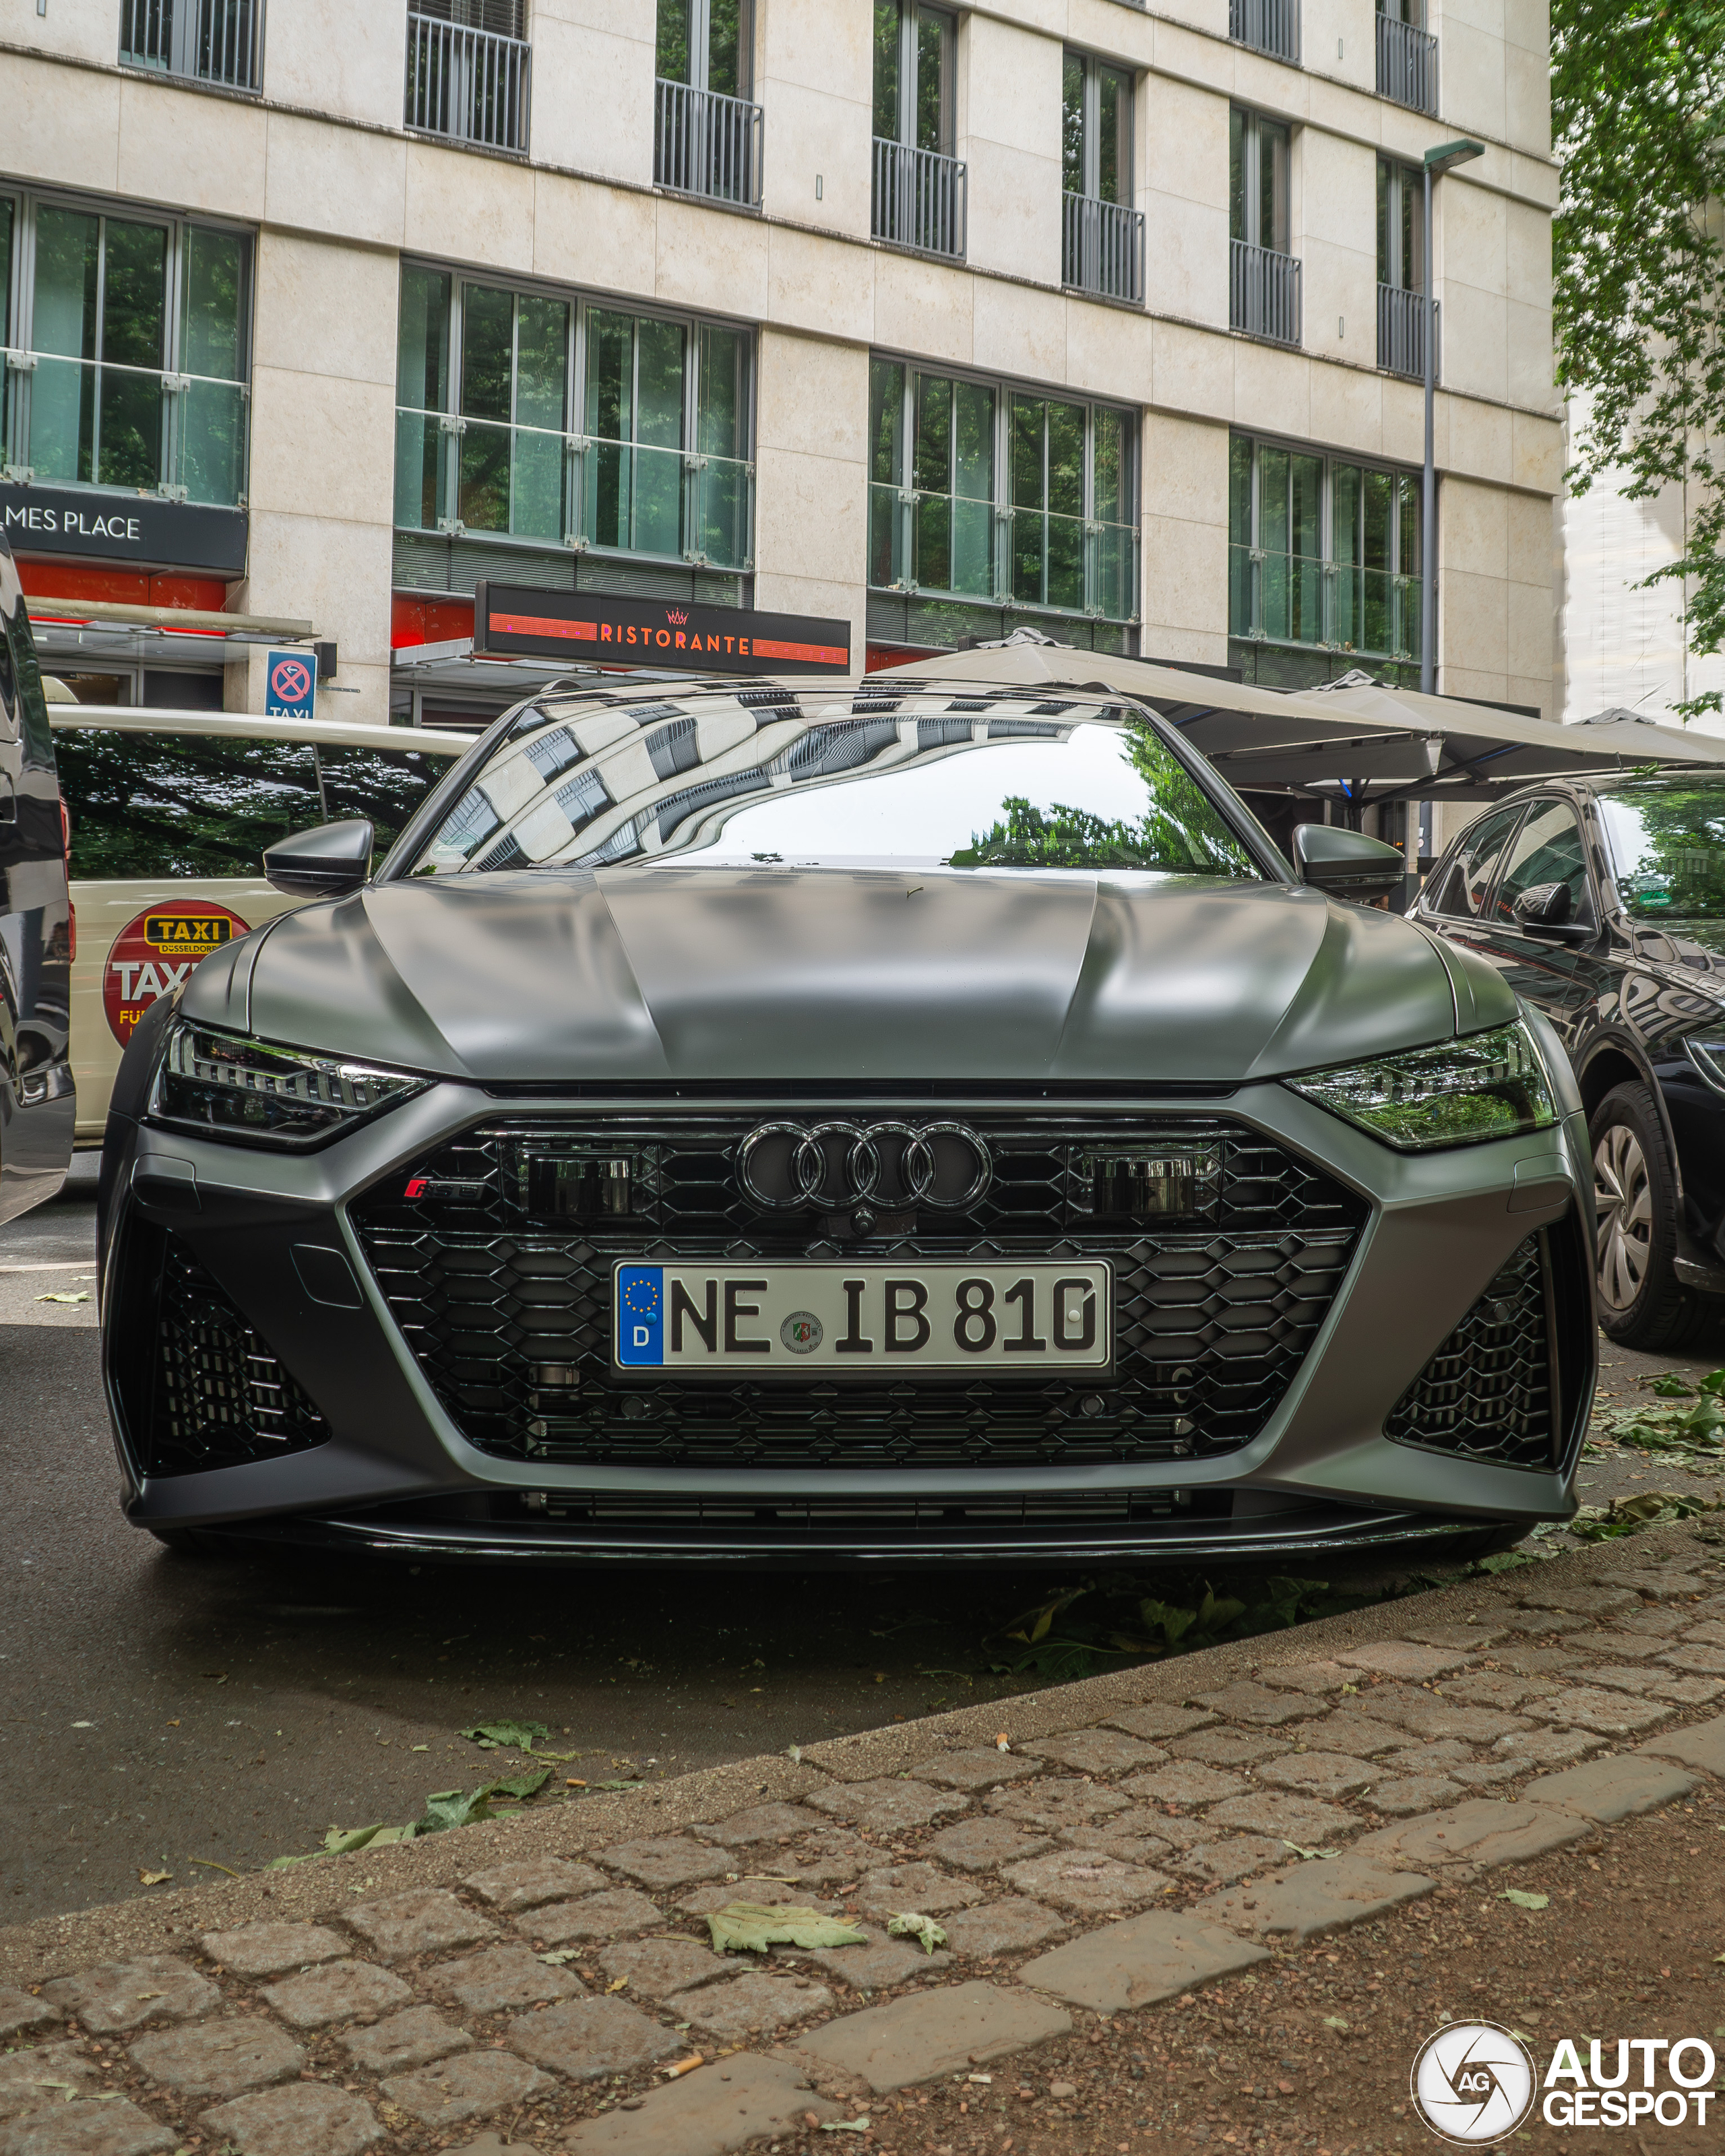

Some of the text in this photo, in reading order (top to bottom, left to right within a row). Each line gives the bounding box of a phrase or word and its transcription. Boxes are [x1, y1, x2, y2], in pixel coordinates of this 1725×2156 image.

[0, 505, 141, 540] MES PLACE
[600, 623, 749, 656] RISTORANTE
[158, 922, 219, 940] TAXI
[111, 962, 199, 1001] TAX
[670, 1278, 1097, 1353] NE IB 810
[633, 1326, 650, 1347] D
